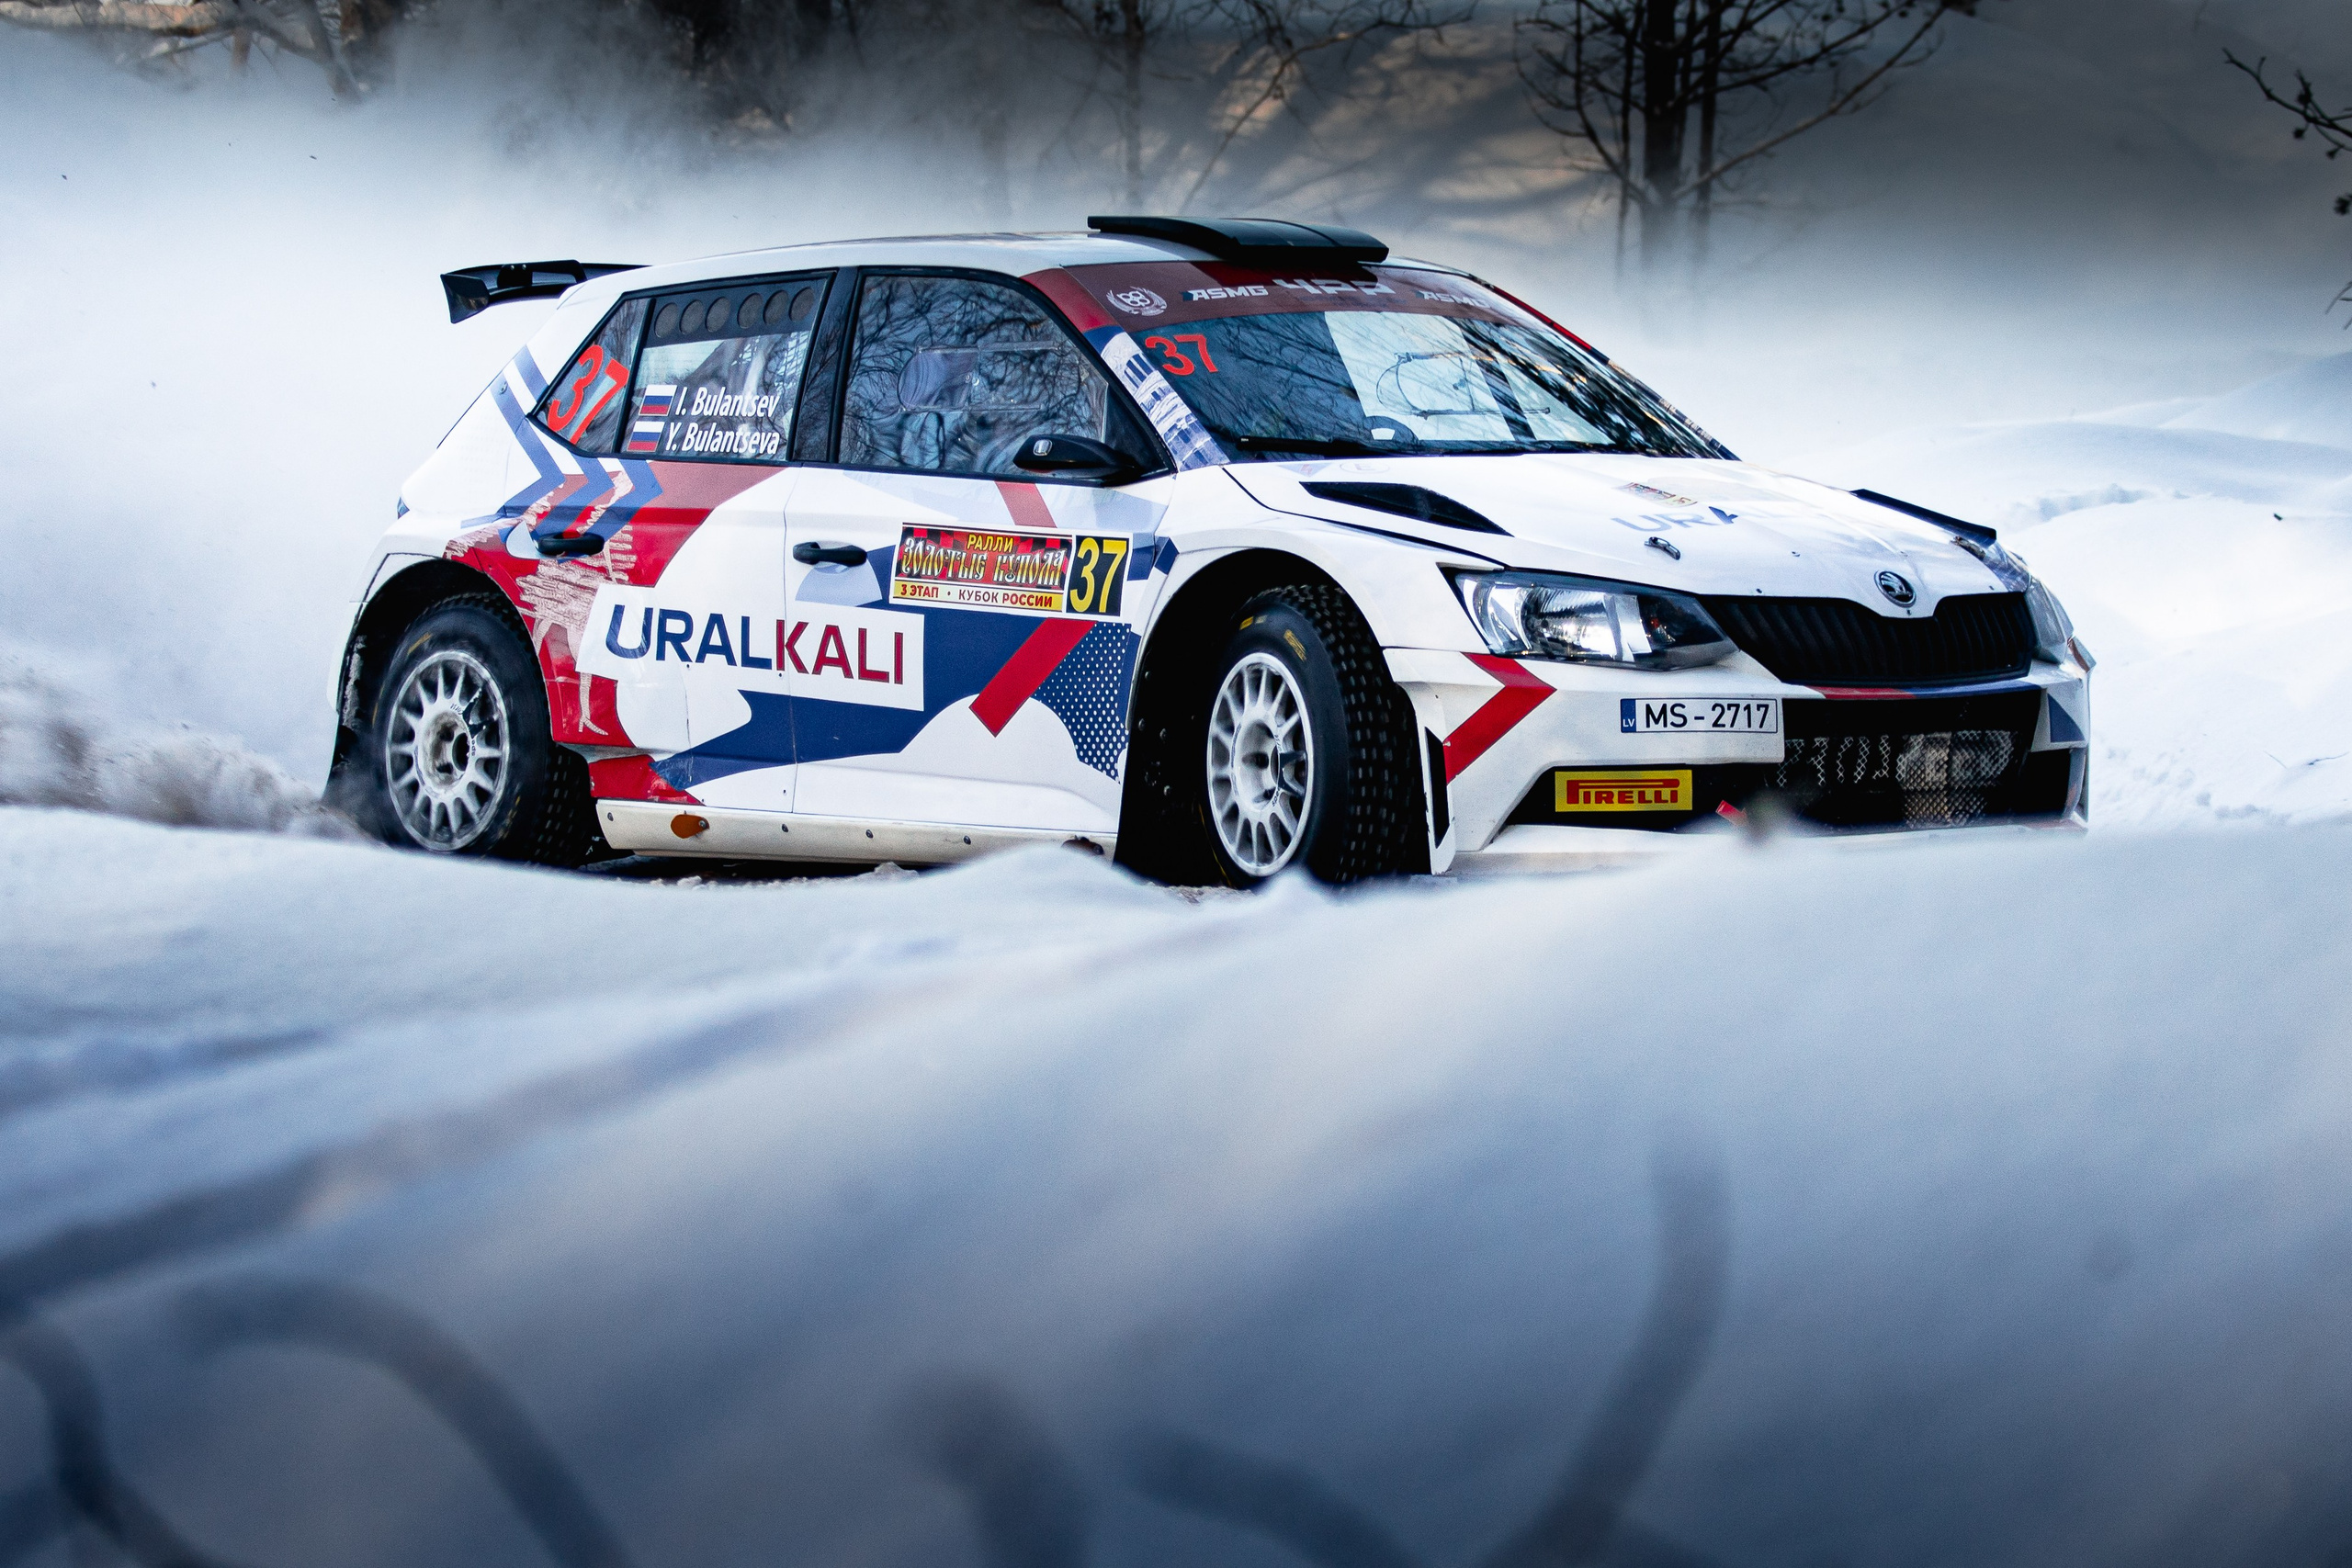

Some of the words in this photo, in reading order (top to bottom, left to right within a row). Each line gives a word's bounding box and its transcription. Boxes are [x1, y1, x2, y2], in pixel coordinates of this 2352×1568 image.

[1192, 285, 1269, 301] ASMG
[1145, 333, 1218, 376] 37
[548, 344, 630, 445] 37
[674, 388, 687, 417] I.
[691, 387, 781, 417] Bulantsev
[664, 423, 681, 452] Y.
[681, 423, 780, 455] Bulantseva
[967, 534, 1013, 553] РАЛЛИ
[900, 536, 988, 581] ЗОЛОТЫЕ
[993, 550, 1065, 586] КУПОЛА
[1069, 536, 1128, 614] 37
[900, 583, 908, 596] 3
[910, 585, 939, 598] ЭТАП
[958, 591, 999, 604] КУБОК
[1002, 592, 1053, 607] РОССИИ
[605, 604, 904, 684] URALKALI
[1623, 718, 1635, 728] LV
[1566, 779, 1680, 805] PIRELLI
